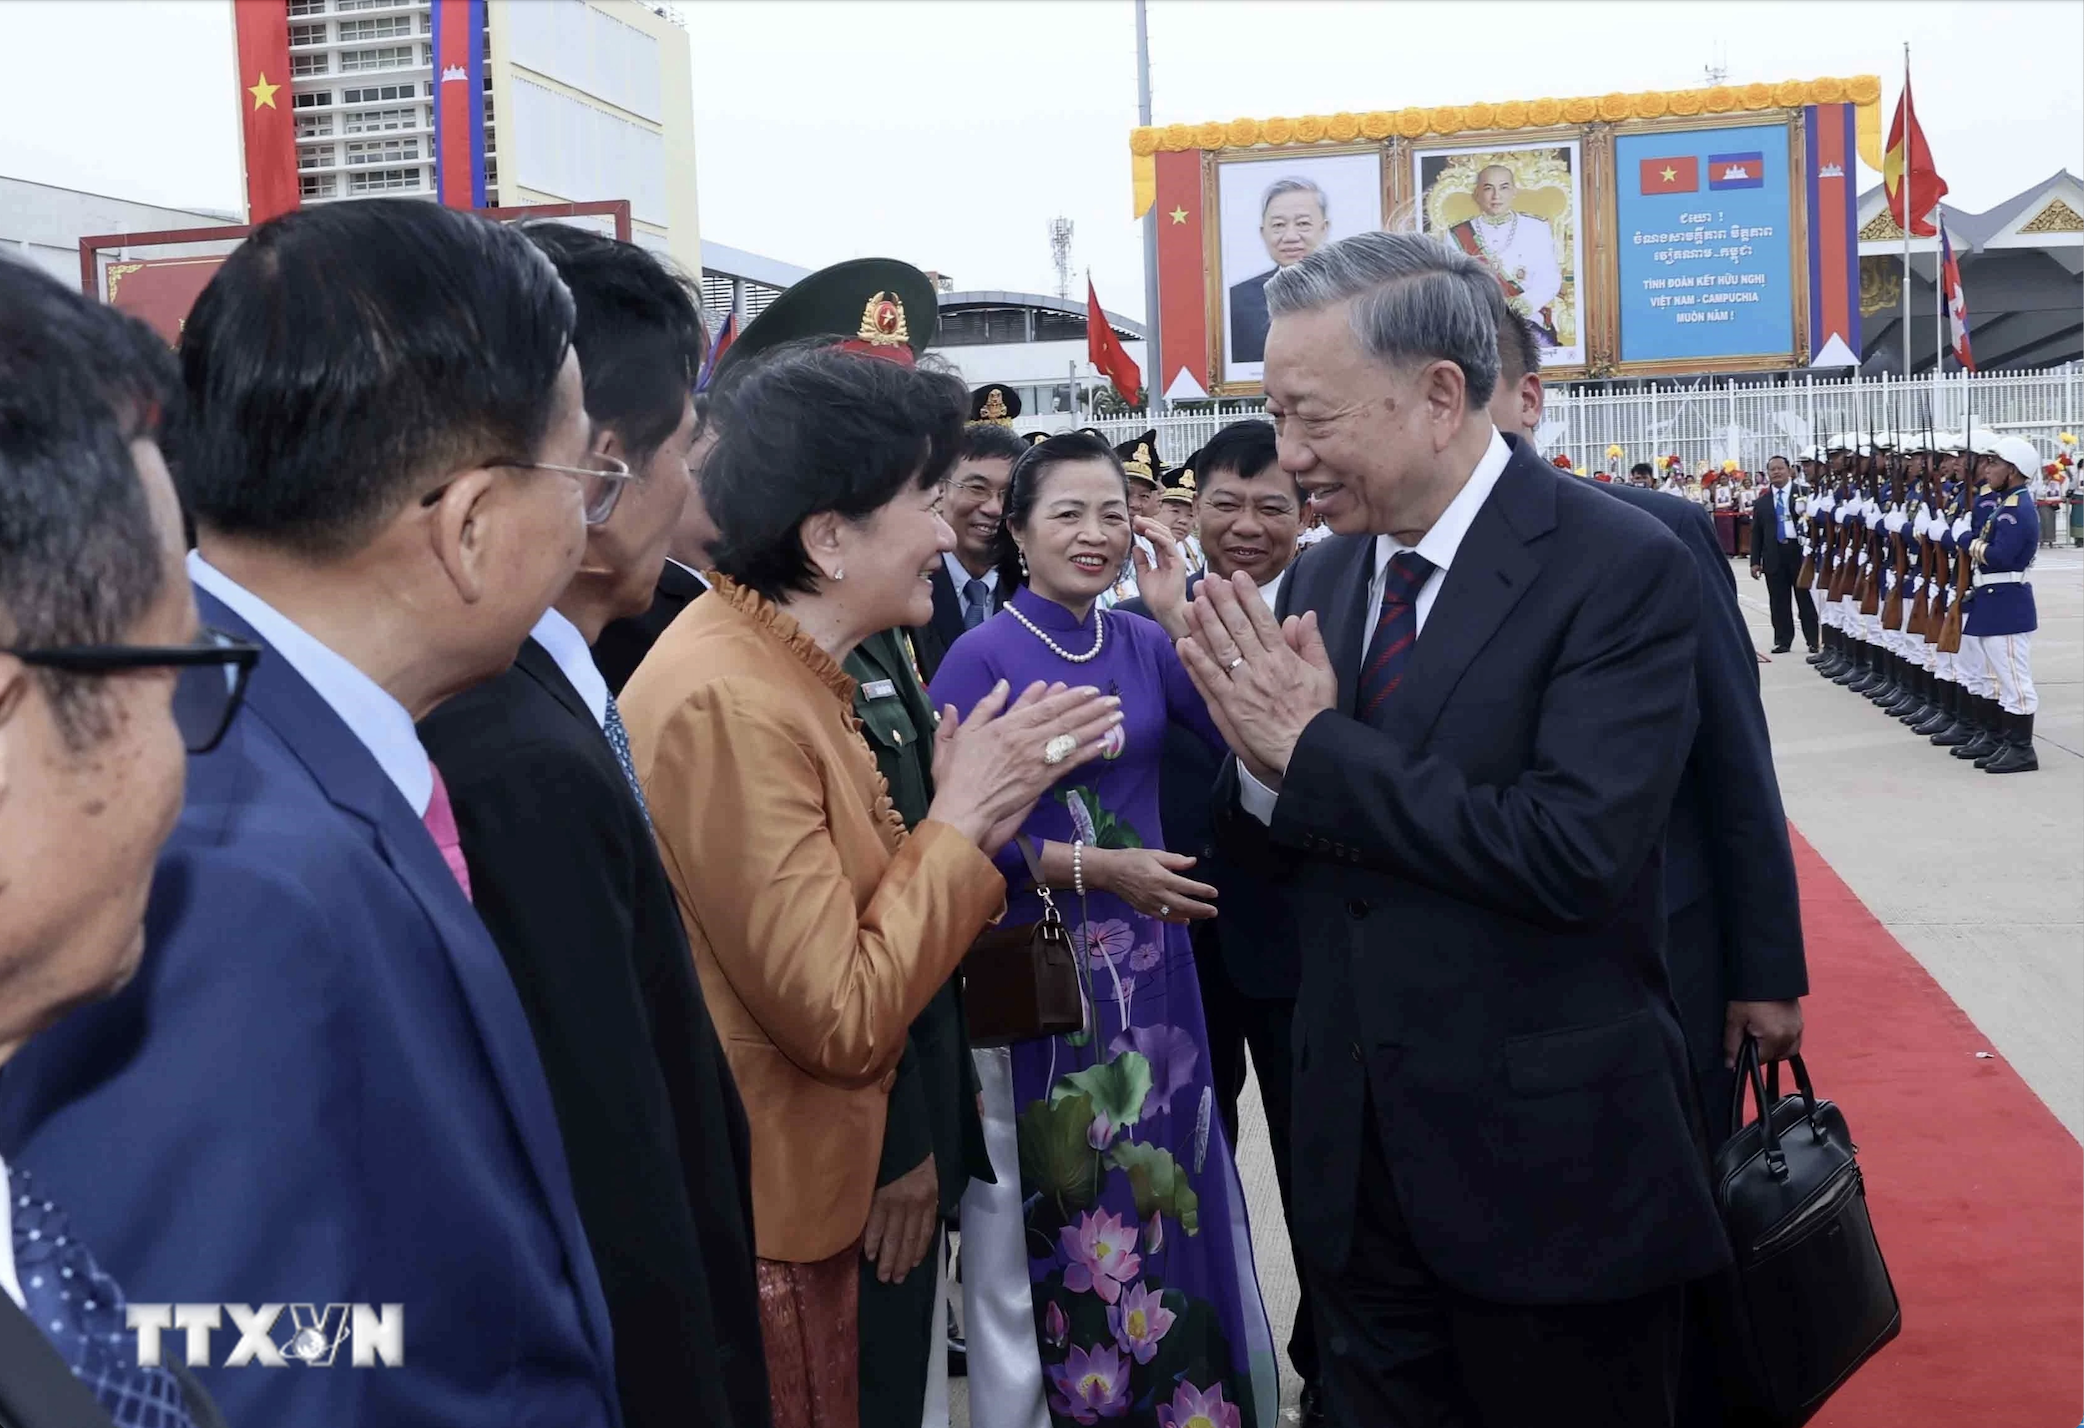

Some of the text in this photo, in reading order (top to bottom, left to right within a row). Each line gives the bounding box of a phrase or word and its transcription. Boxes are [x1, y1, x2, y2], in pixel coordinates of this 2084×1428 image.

[1718, 211, 1724, 222] !
[1642, 272, 1766, 290] TÌNH ĐOÀN KẾT HỮU NGHỊ
[1650, 294, 1673, 310] VIỆT
[1673, 294, 1695, 306] NAM
[1702, 291, 1760, 304] CAMPUCHIA
[1676, 308, 1735, 323] MUÔN NĂM !
